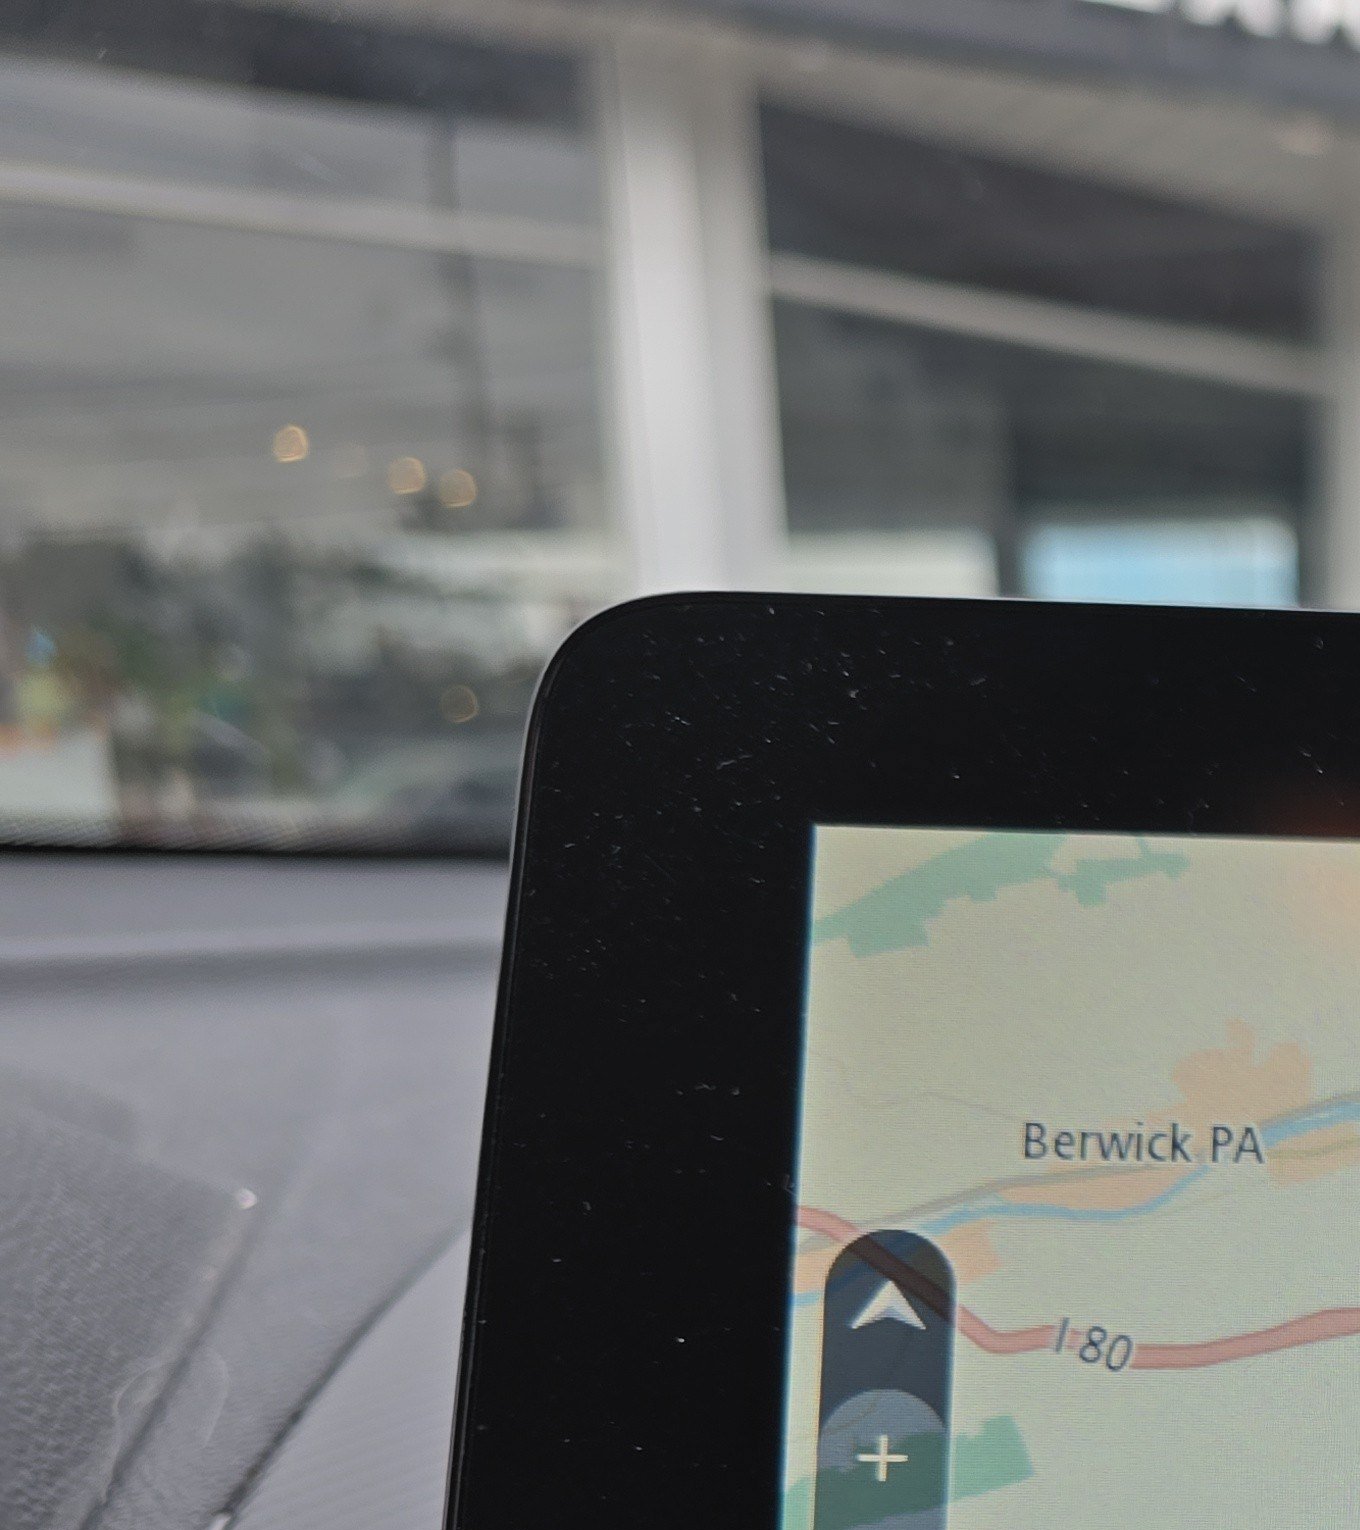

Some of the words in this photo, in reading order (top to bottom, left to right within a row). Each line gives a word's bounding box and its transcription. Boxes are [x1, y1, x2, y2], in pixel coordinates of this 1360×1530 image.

[1024, 1120, 1193, 1162] Berwick
[1211, 1125, 1265, 1164] PA
[1079, 1325, 1133, 1373] 80
